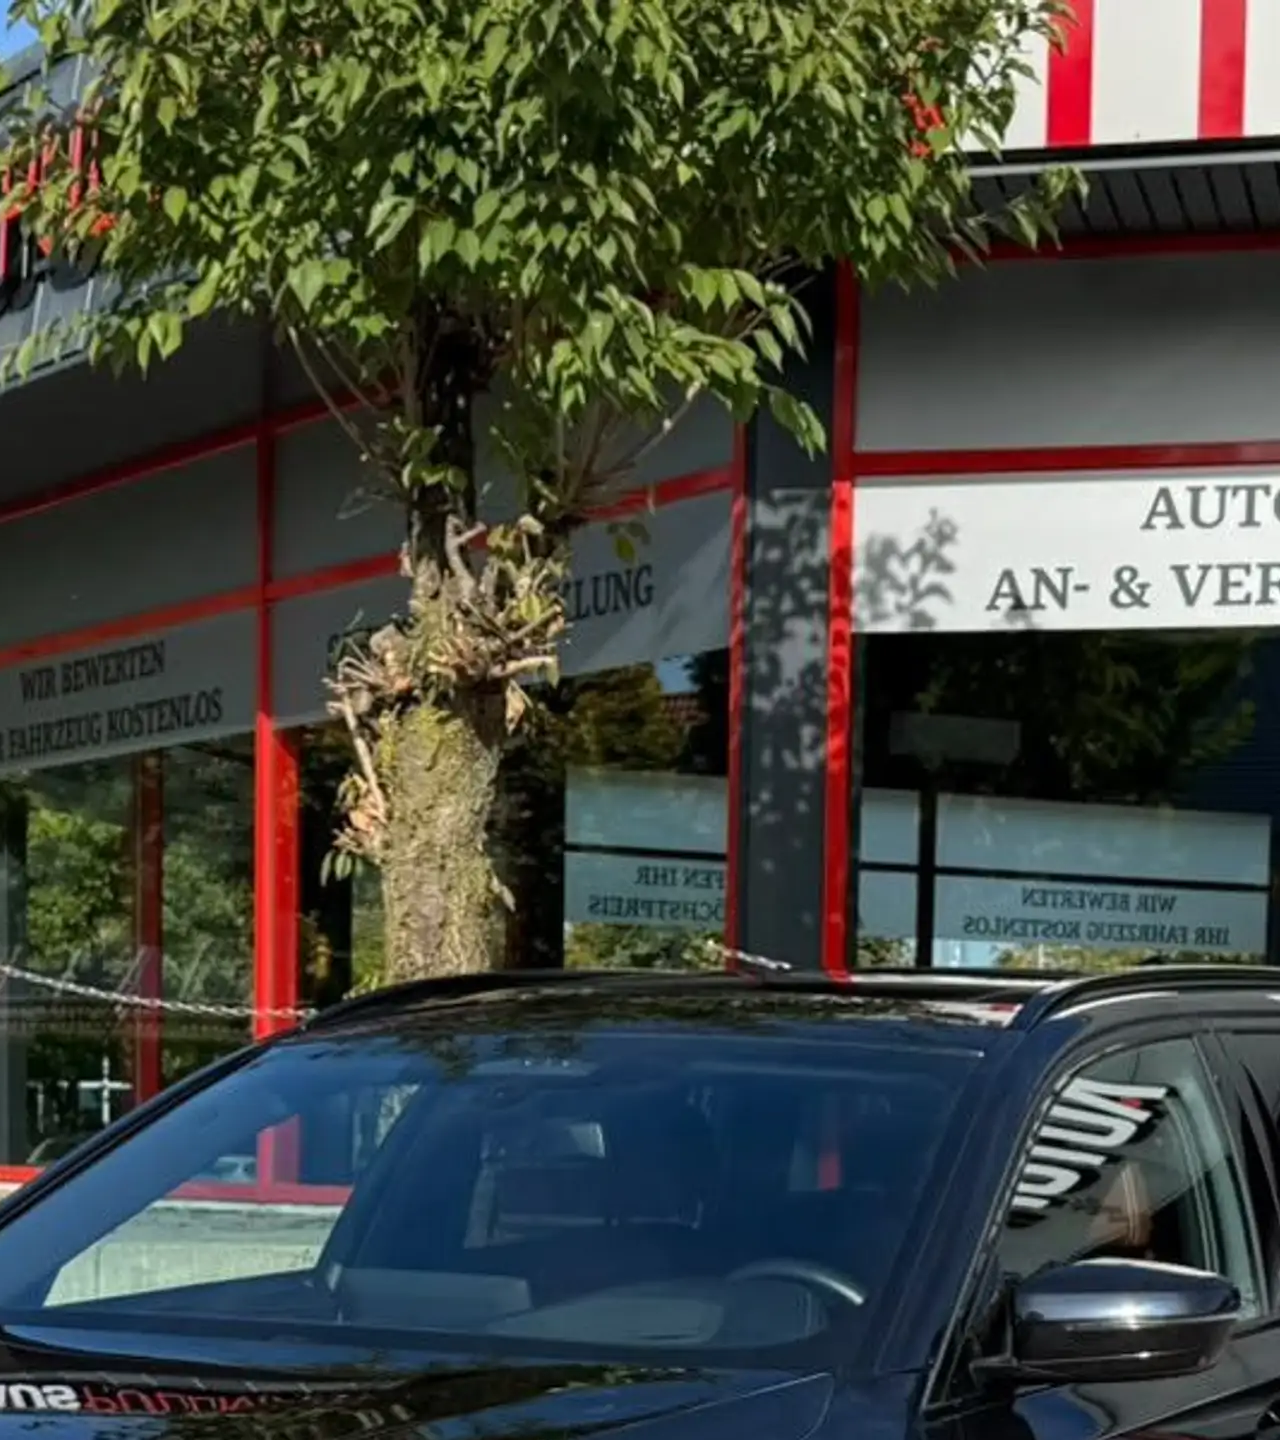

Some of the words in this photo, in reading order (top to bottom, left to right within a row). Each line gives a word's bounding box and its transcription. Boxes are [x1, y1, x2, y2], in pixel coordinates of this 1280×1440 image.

[985, 567, 1090, 611] AN-
[1109, 565, 1151, 609] &
[20, 670, 56, 702] WIR
[61, 641, 166, 696] BEWERTEN
[9, 713, 102, 761] FAHRZEUG
[107, 688, 224, 741] KOSTENLOS
